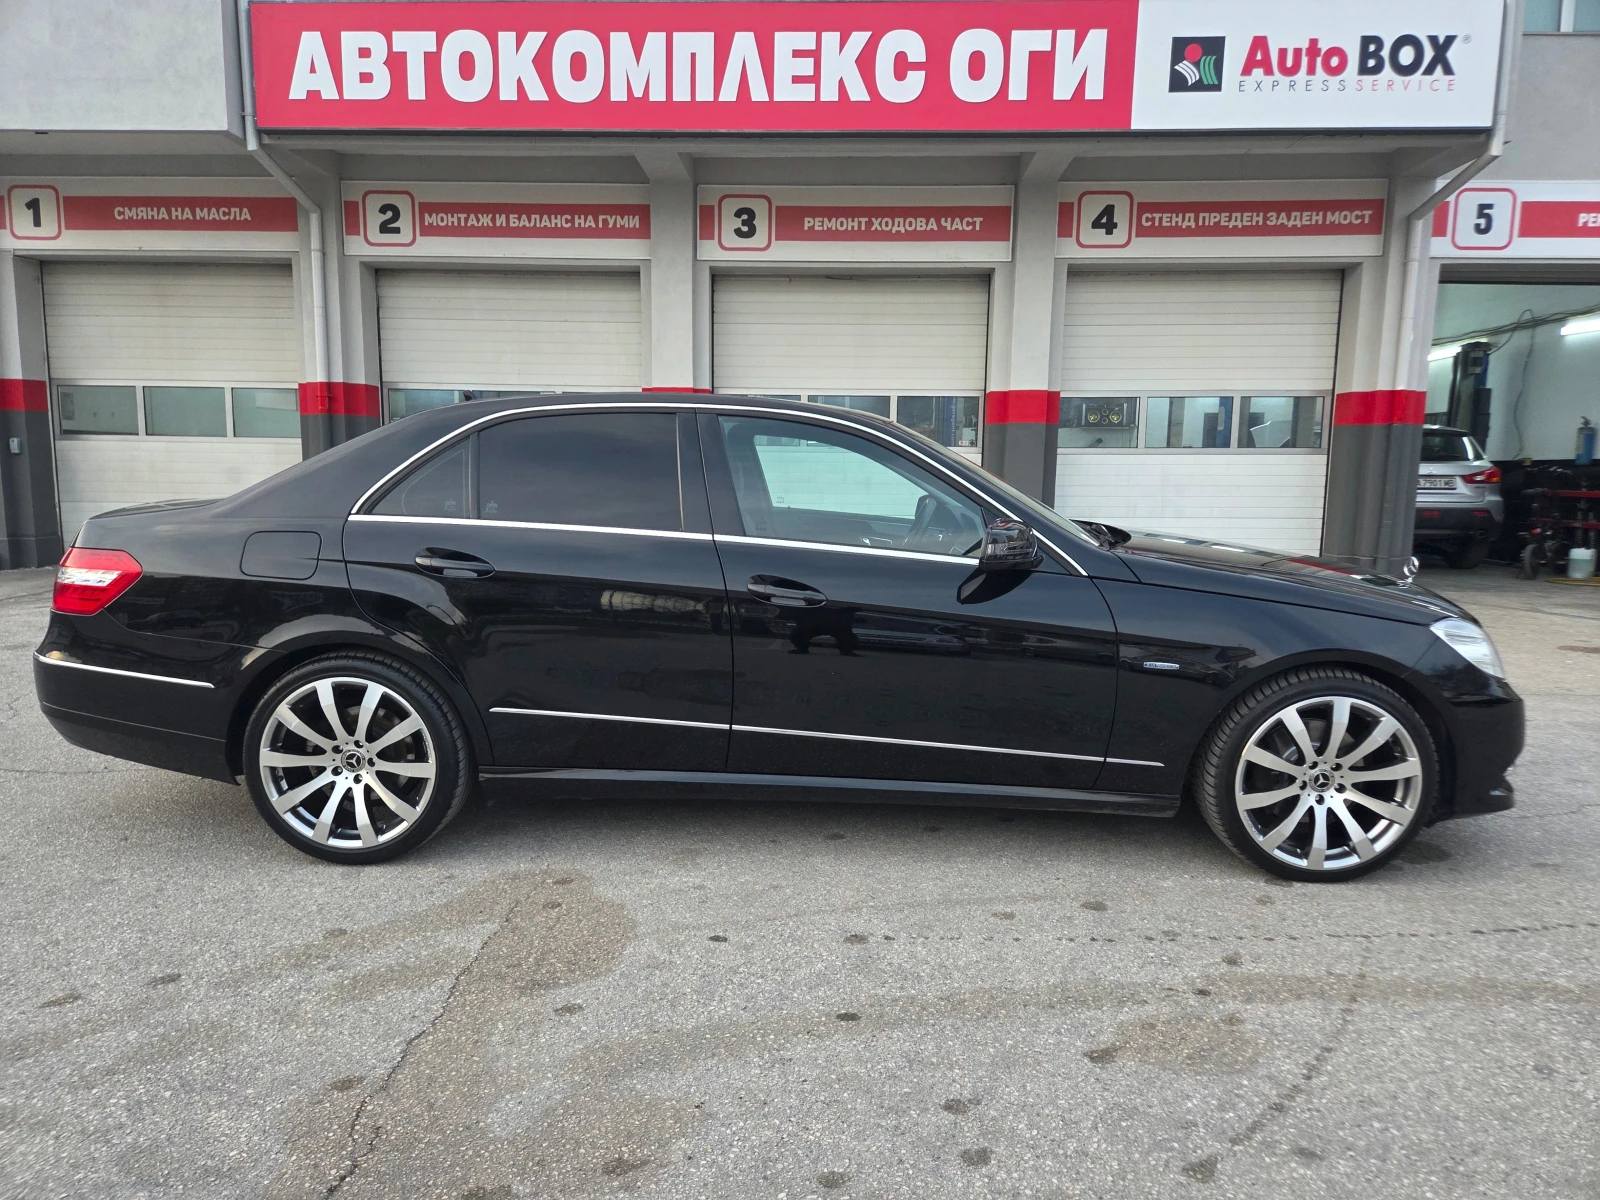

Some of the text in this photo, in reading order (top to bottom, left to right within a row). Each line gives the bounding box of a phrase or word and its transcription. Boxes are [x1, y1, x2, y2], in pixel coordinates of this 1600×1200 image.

[288, 28, 1108, 104] АВТОКОМПЛЕКС ОГИ
[1240, 34, 1458, 77] Auto BOX
[24, 197, 42, 228] 1
[113, 206, 252, 221] СМЯНА НА МАСЛА
[377, 203, 401, 235] 2
[424, 212, 640, 229] МОНТАЖ И БАЛАНС НА ГУМИ
[733, 206, 757, 239] 3
[803, 217, 984, 234] РЕМОНТ ХОДОВА ЧАСТ
[1090, 203, 1119, 236] 4
[1141, 210, 1373, 229] СТЕНД ПРЕДЕН ЗАДЕН МОСТ
[1473, 203, 1495, 236] 5
